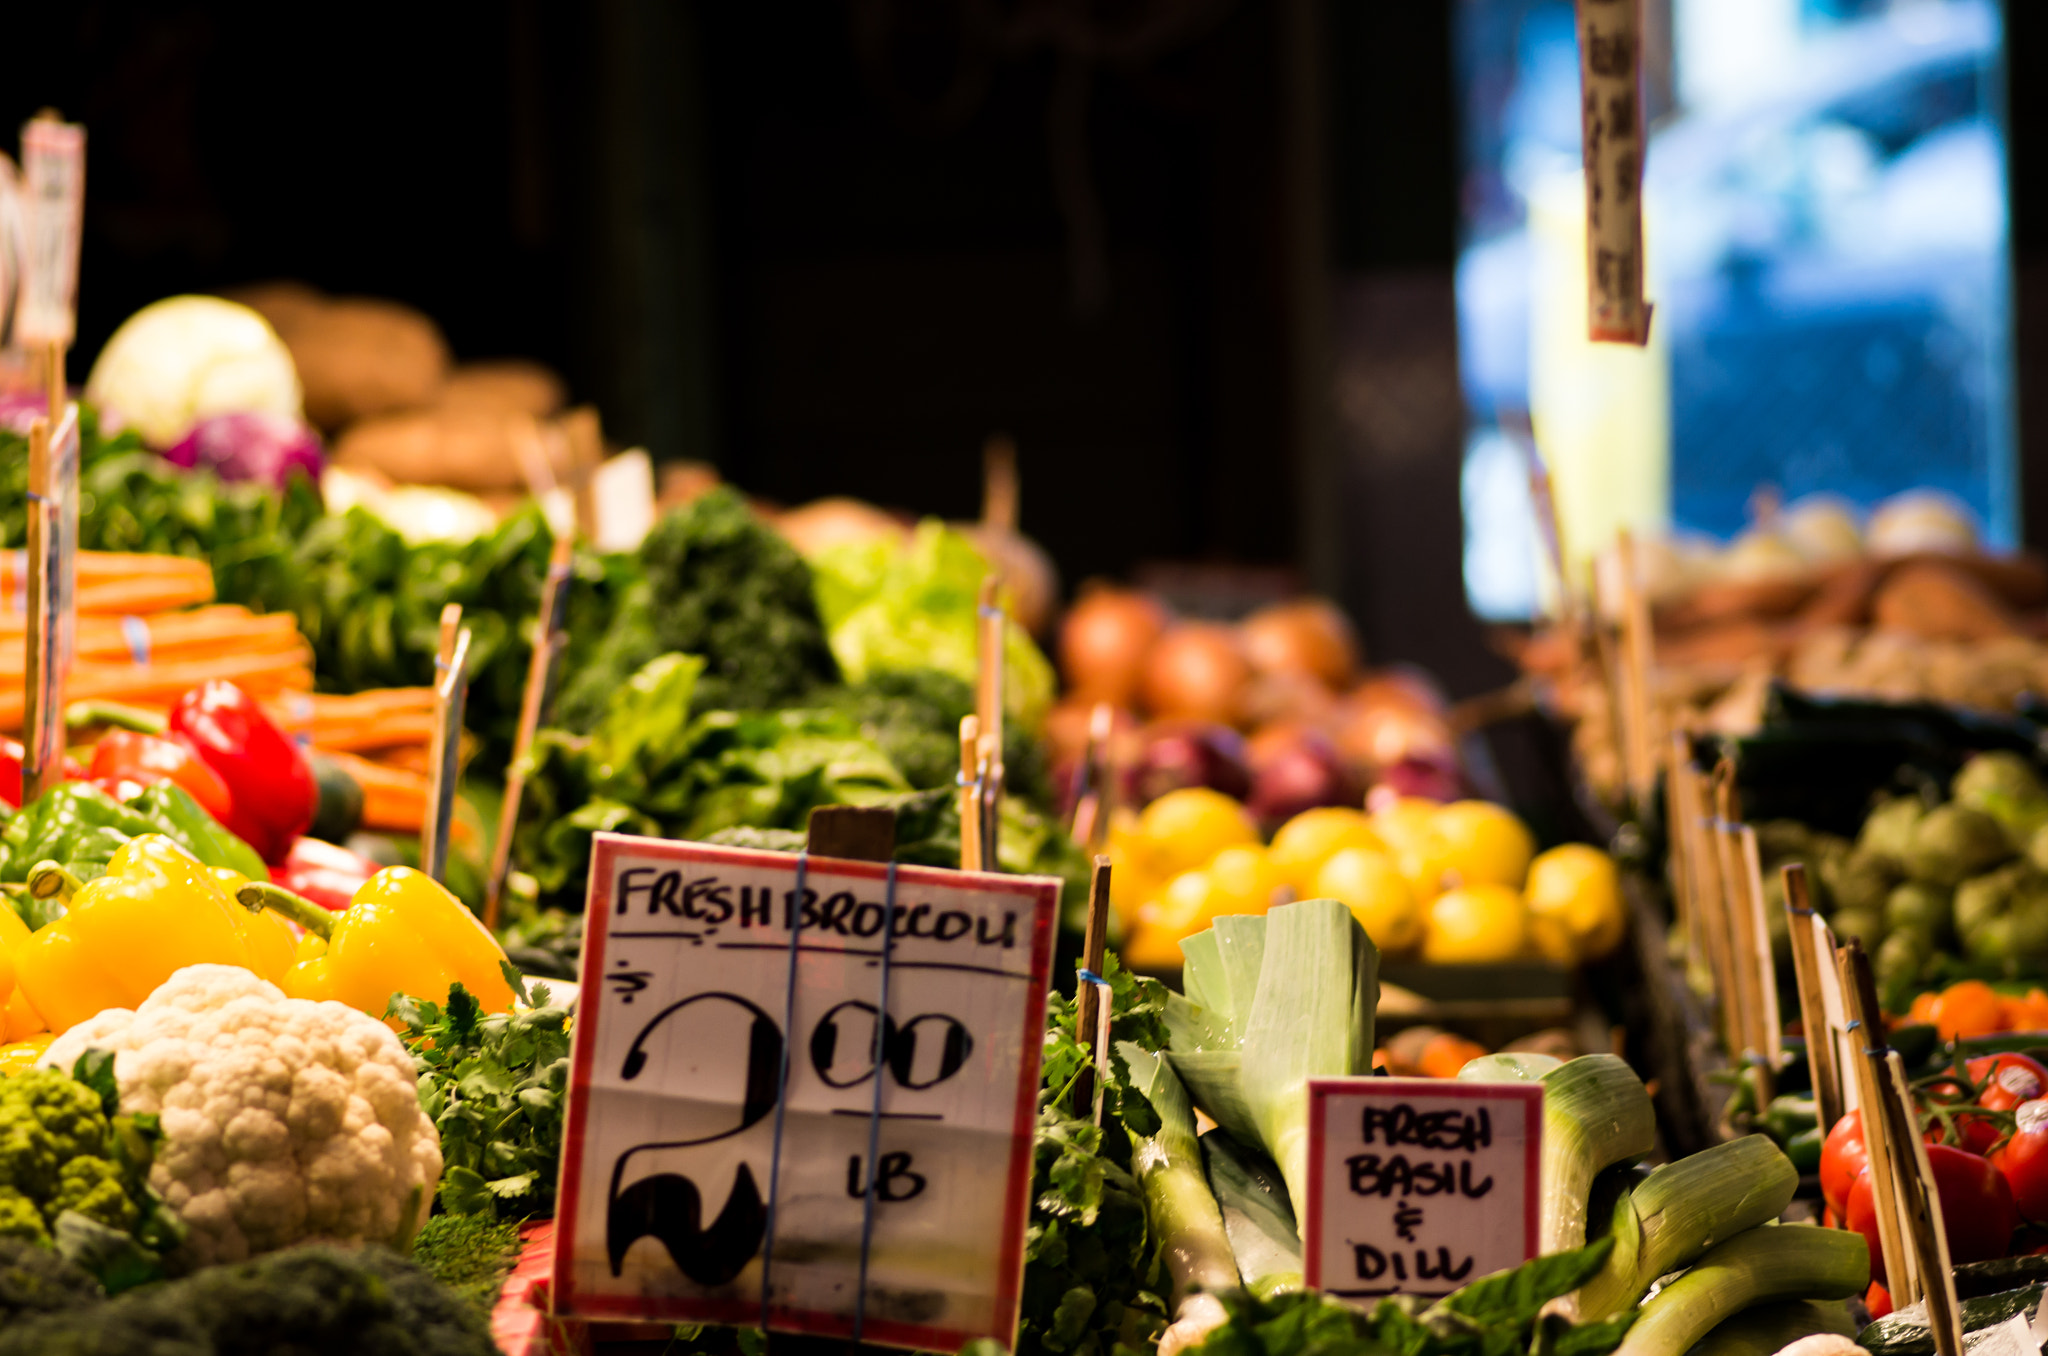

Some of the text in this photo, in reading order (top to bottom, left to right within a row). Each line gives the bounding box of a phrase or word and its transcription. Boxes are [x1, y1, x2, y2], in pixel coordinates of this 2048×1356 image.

[616, 868, 1018, 949] FRESH BROCCOLI
[1362, 1103, 1493, 1153] FRESH
[847, 1151, 927, 1203] LB
[1345, 1154, 1495, 1199] BASIL
[1349, 1244, 1474, 1282] DILL
